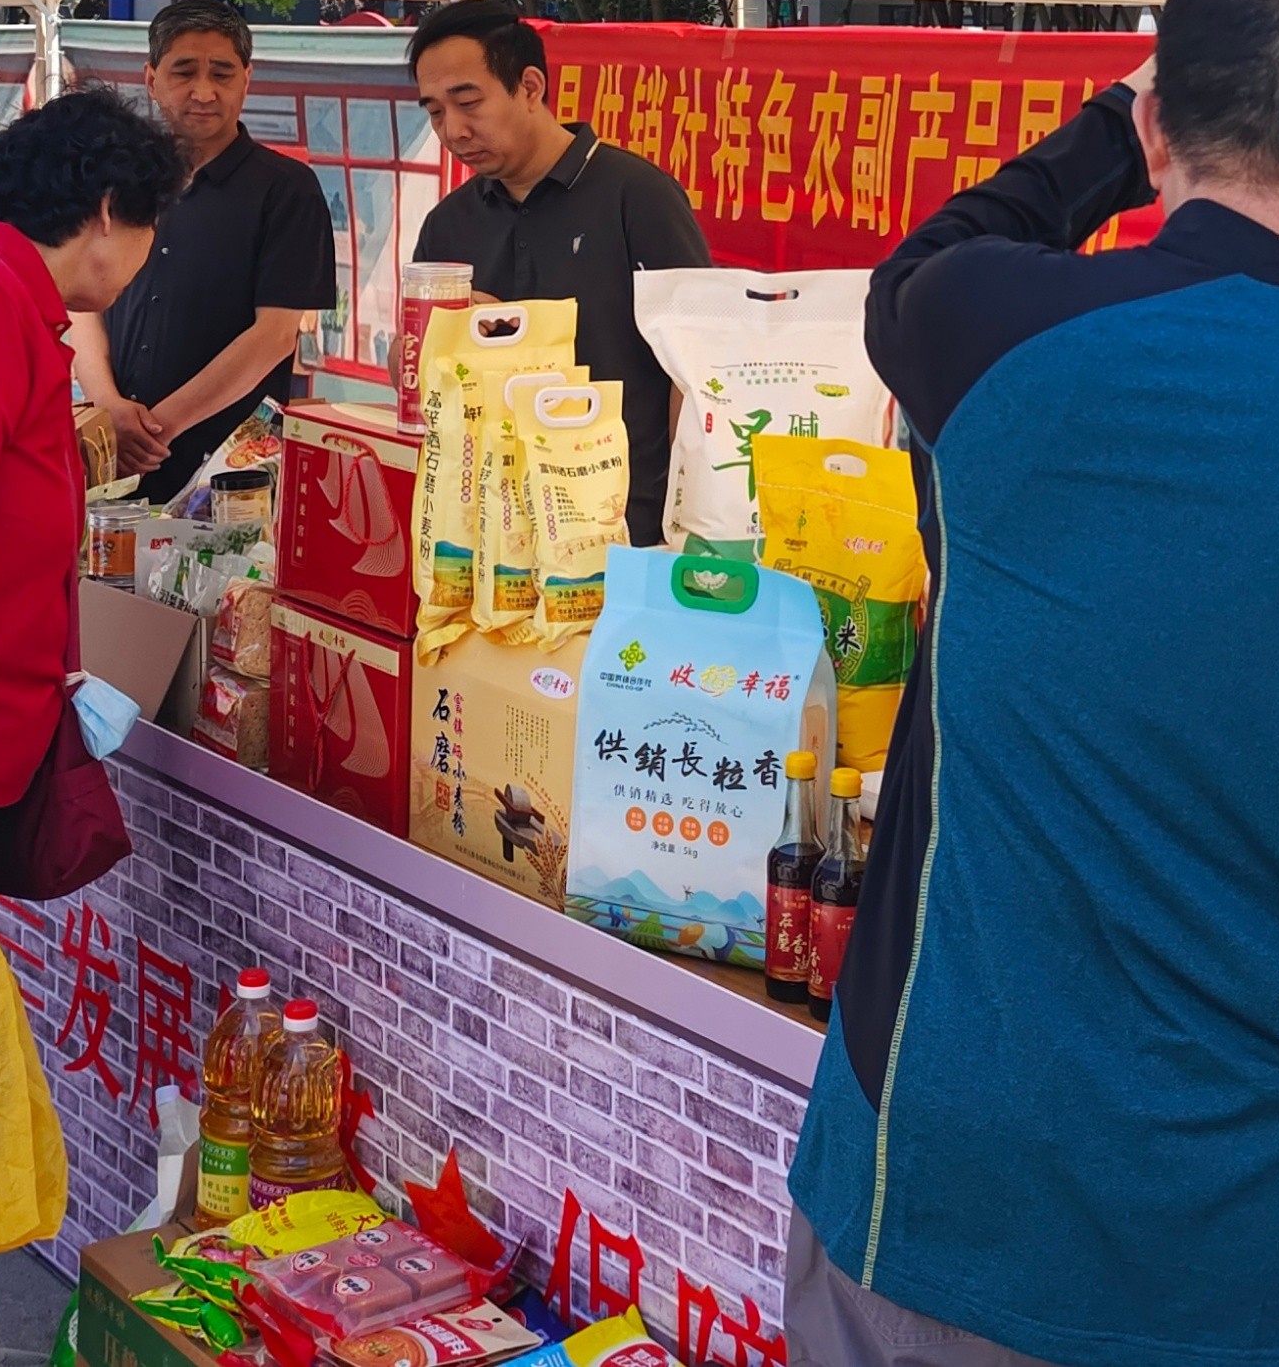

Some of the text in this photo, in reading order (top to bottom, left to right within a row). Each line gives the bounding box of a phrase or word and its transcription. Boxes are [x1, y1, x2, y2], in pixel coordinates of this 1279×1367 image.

[430, 688, 451, 775] 石磨
[594, 728, 784, 793] 供銷長粒香
[613, 783, 744, 819] 供销精选 吃得放心
[682, 845, 699, 859] 5kg
